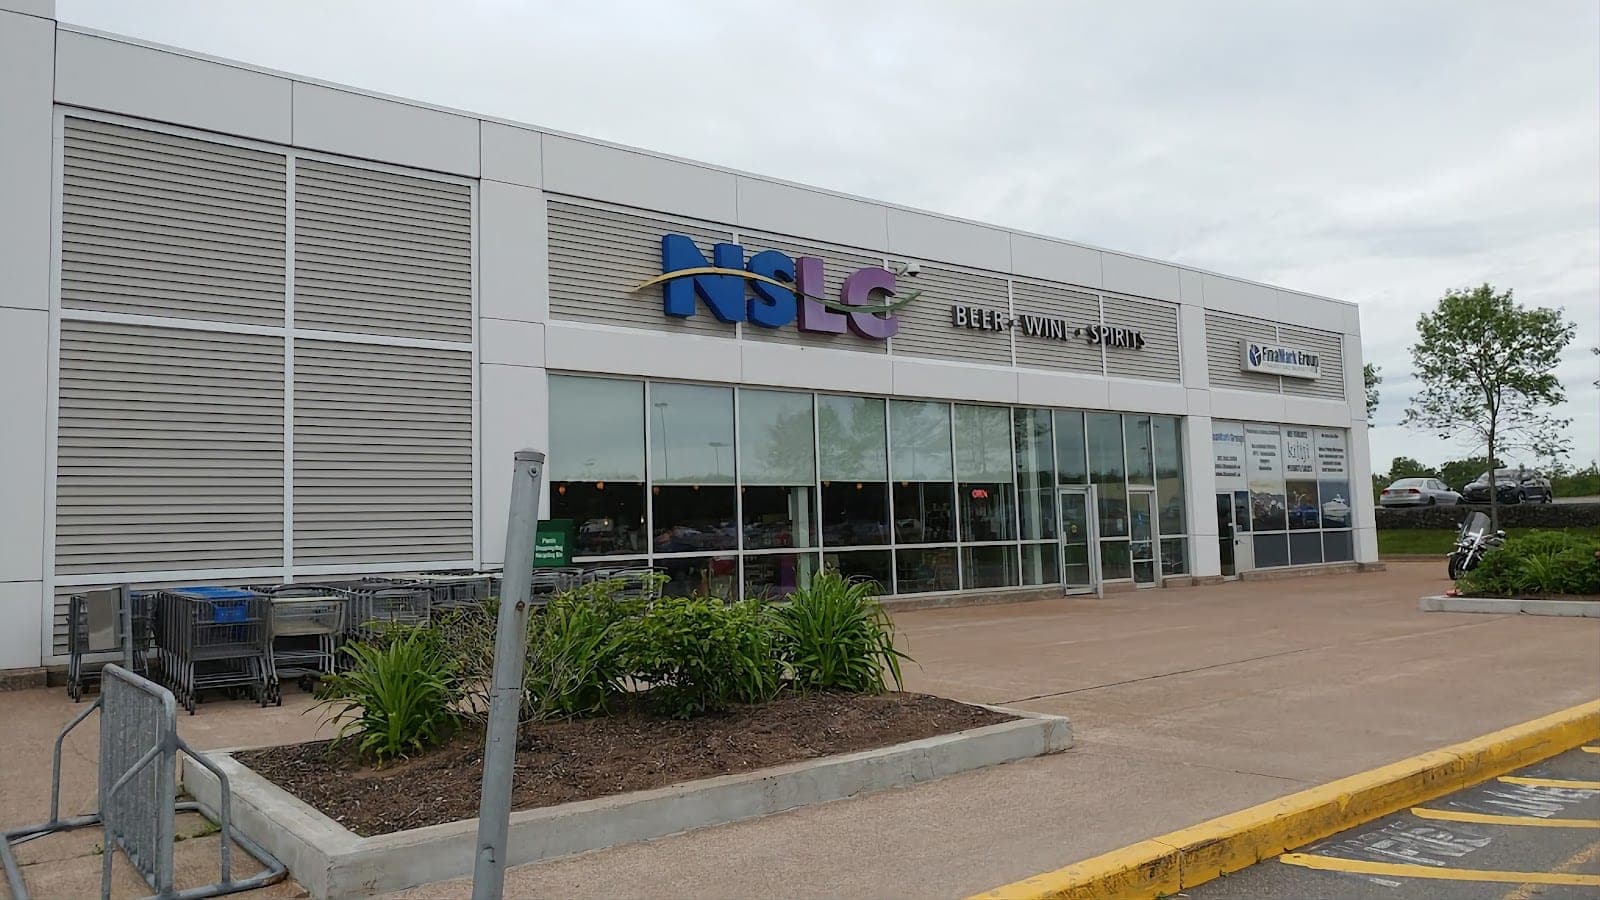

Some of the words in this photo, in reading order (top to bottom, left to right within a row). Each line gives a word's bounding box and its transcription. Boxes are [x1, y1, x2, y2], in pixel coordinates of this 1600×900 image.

[661, 233, 899, 340] NSLC
[953, 305, 1004, 331] BEER
[1088, 324, 1147, 350] SPIRITS
